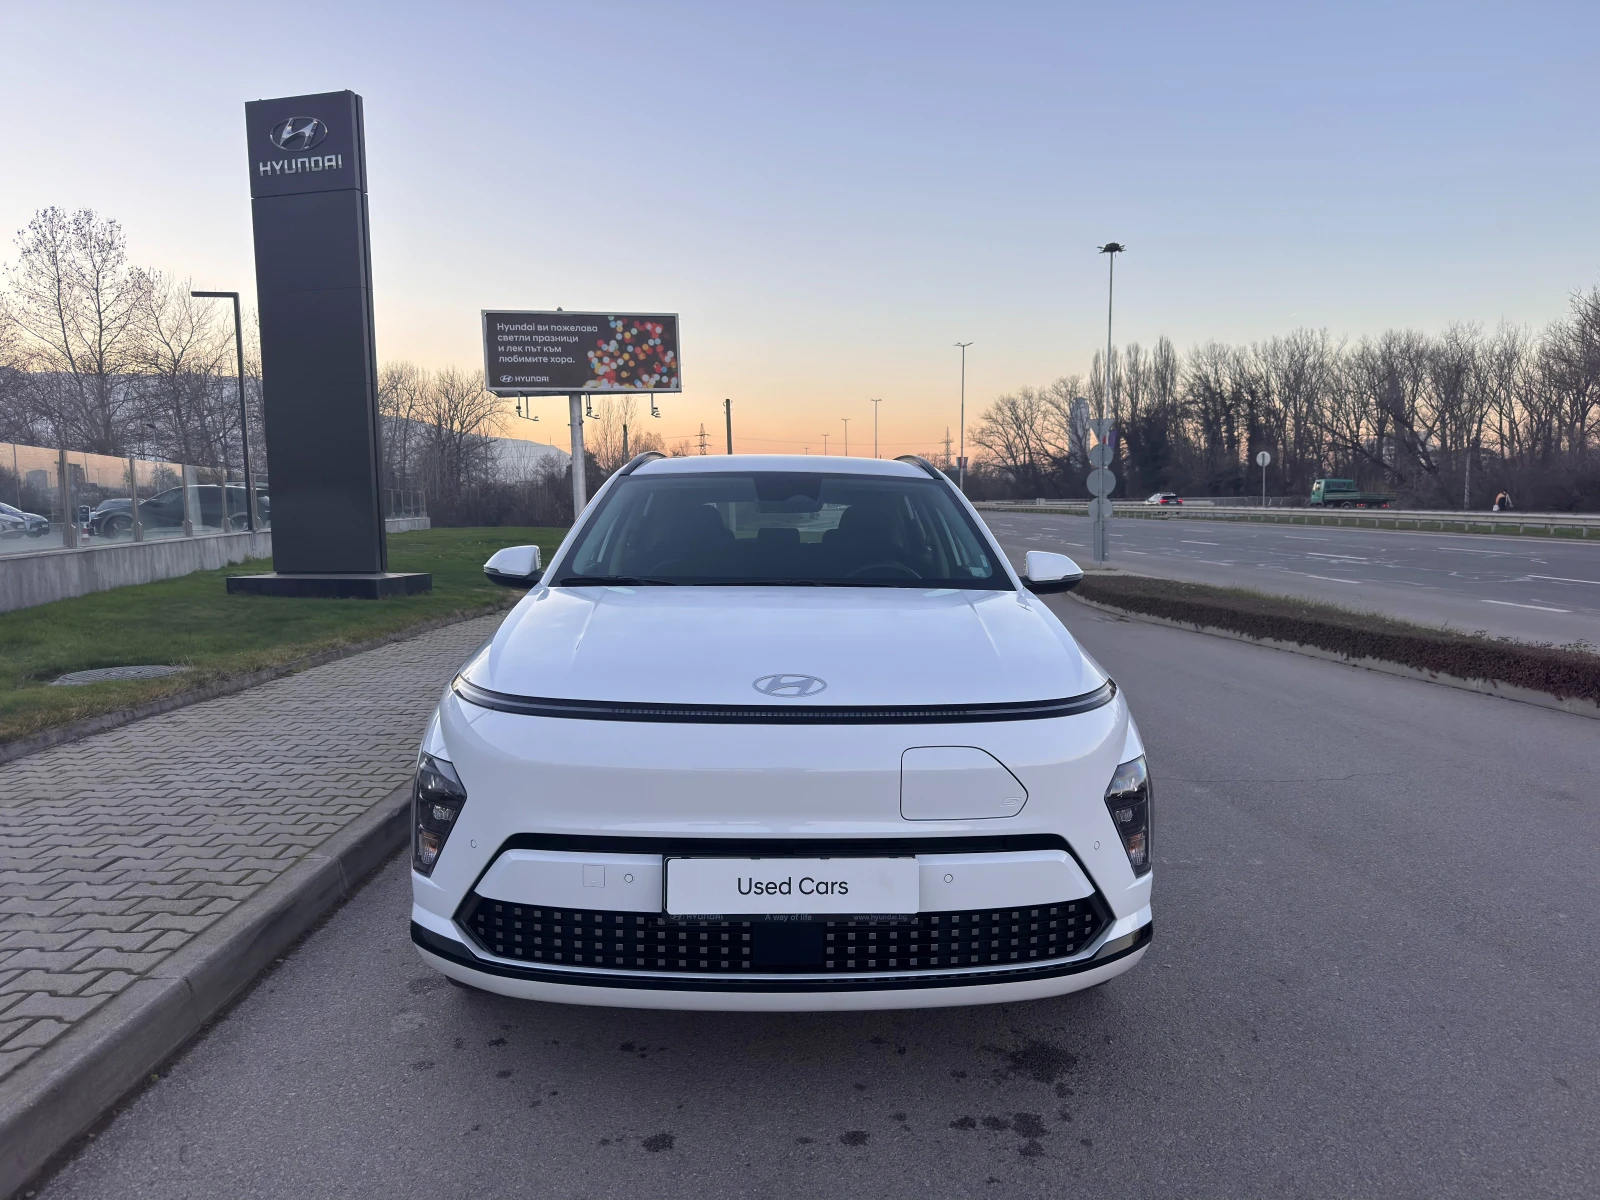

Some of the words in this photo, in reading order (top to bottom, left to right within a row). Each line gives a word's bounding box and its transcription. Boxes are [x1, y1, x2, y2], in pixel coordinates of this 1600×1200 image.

[259, 154, 343, 177] HYUNDAI
[497, 322, 536, 332] Hyundai
[551, 324, 598, 332] пожелава
[532, 335, 579, 343] празници
[499, 355, 548, 363] любимите
[550, 356, 576, 364] хора.
[514, 375, 549, 383] HYUNDAI
[737, 876, 792, 896] Used
[798, 876, 849, 896] Cars
[773, 914, 789, 923] way
[790, 913, 799, 921] of
[800, 913, 812, 921] life
